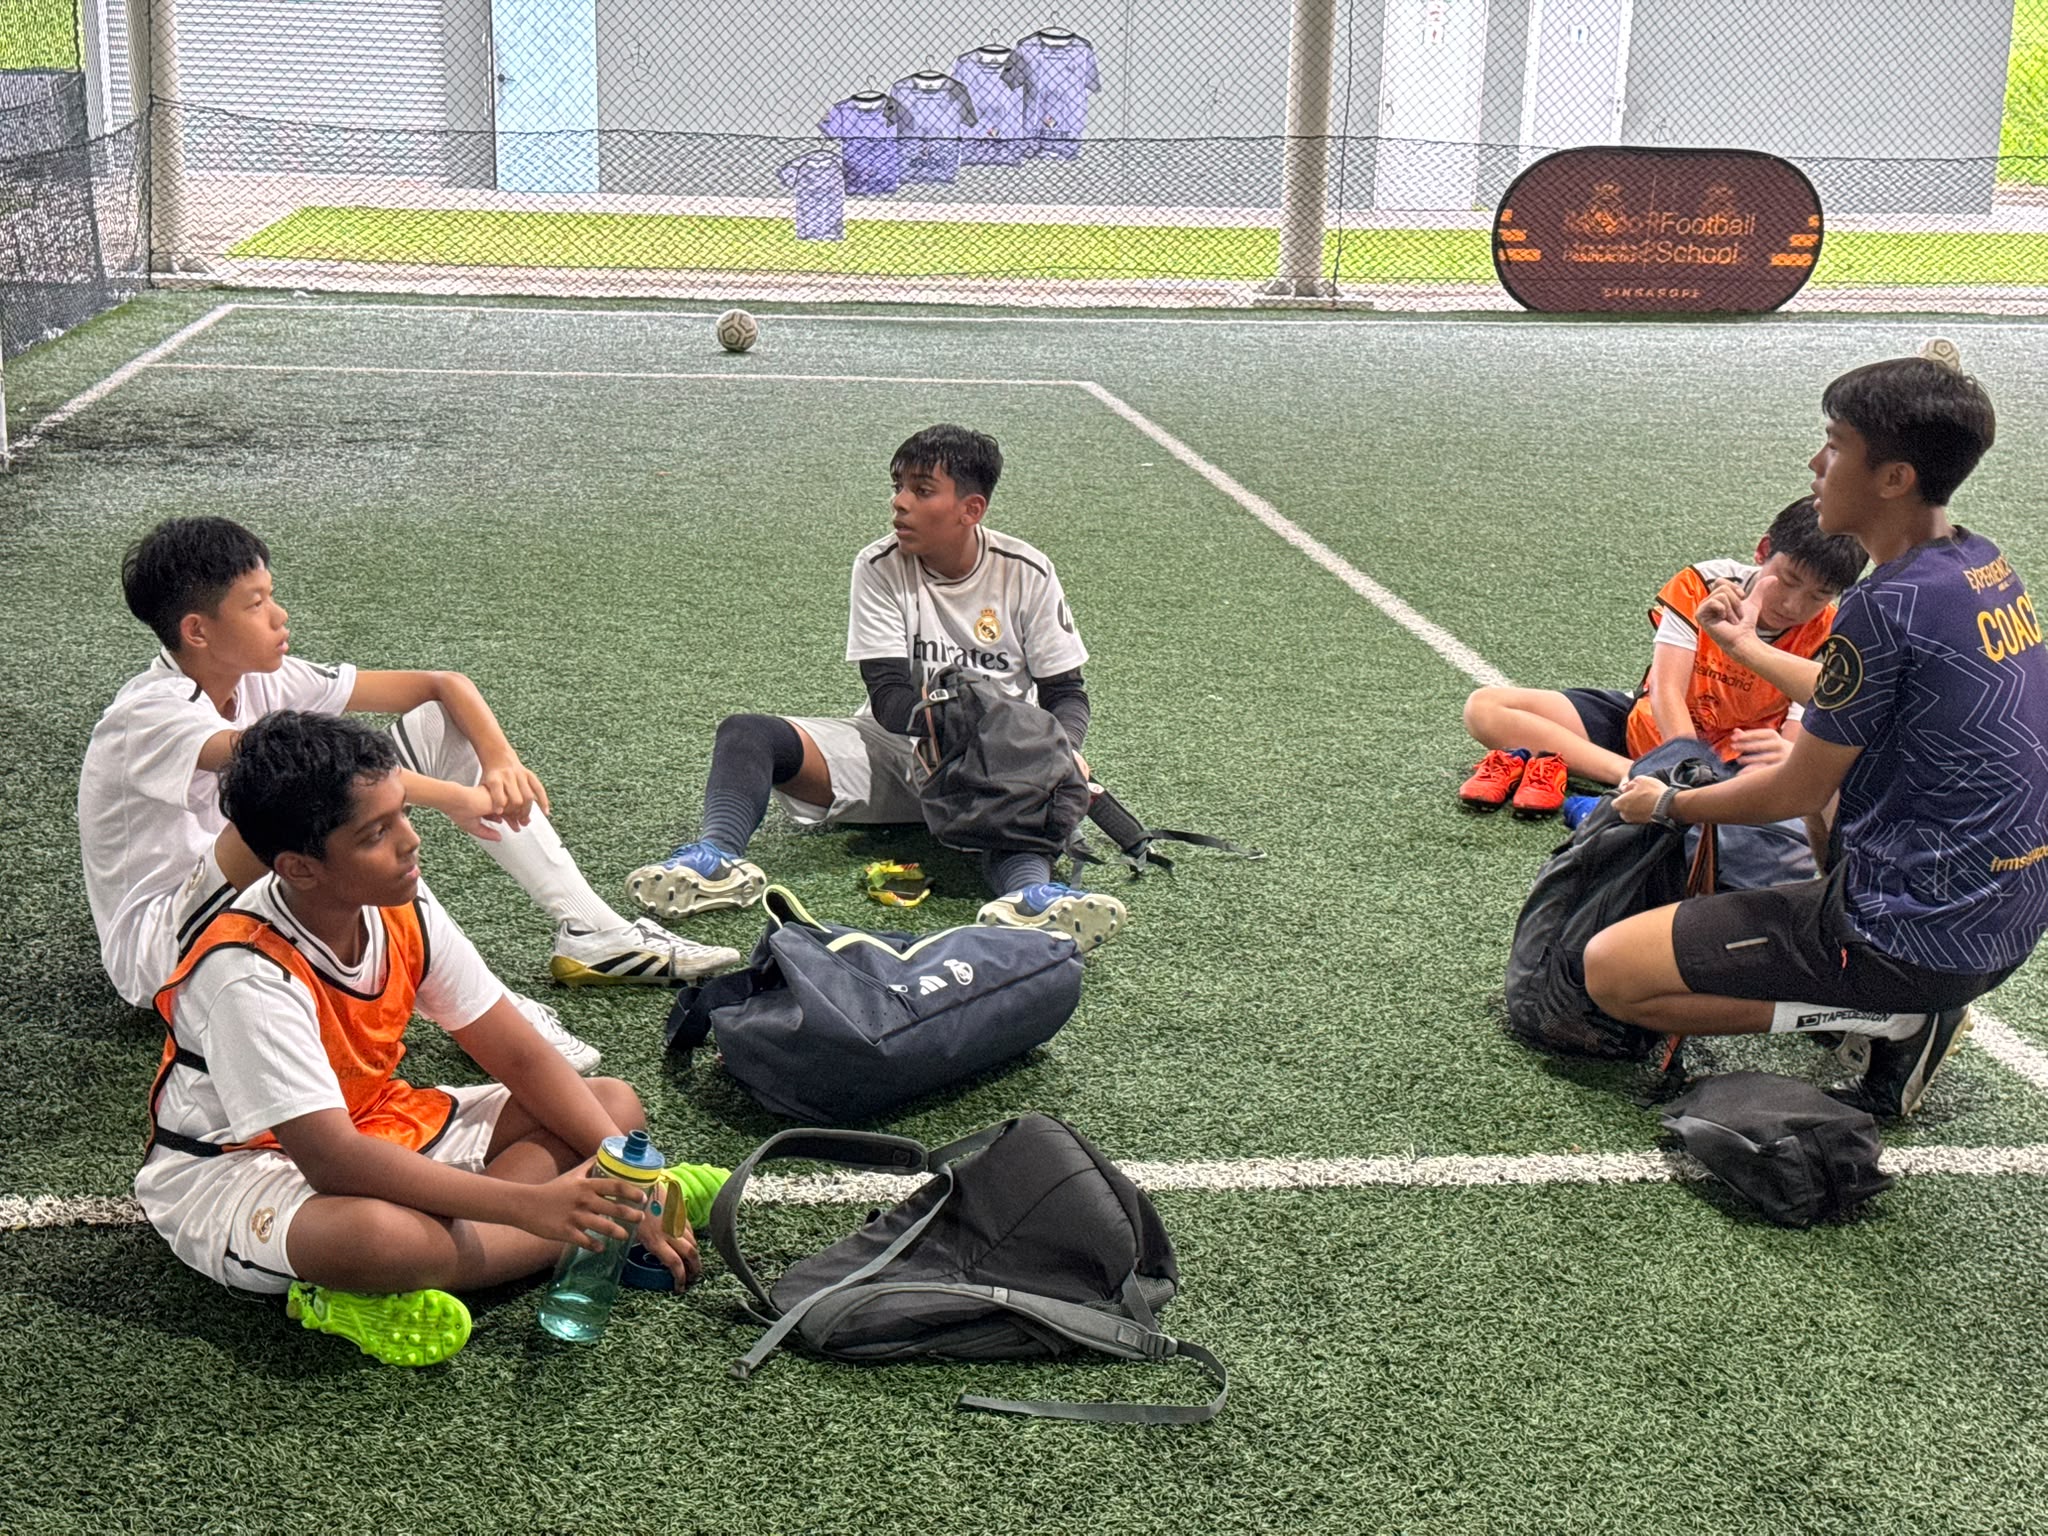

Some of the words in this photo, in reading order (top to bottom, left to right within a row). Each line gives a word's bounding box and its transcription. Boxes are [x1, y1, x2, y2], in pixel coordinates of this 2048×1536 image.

[1660, 212, 1756, 235] Football
[1655, 240, 1739, 264] School
[914, 633, 1010, 670] Emirates
[1821, 1010, 1892, 1023] TAPEDESIGN
